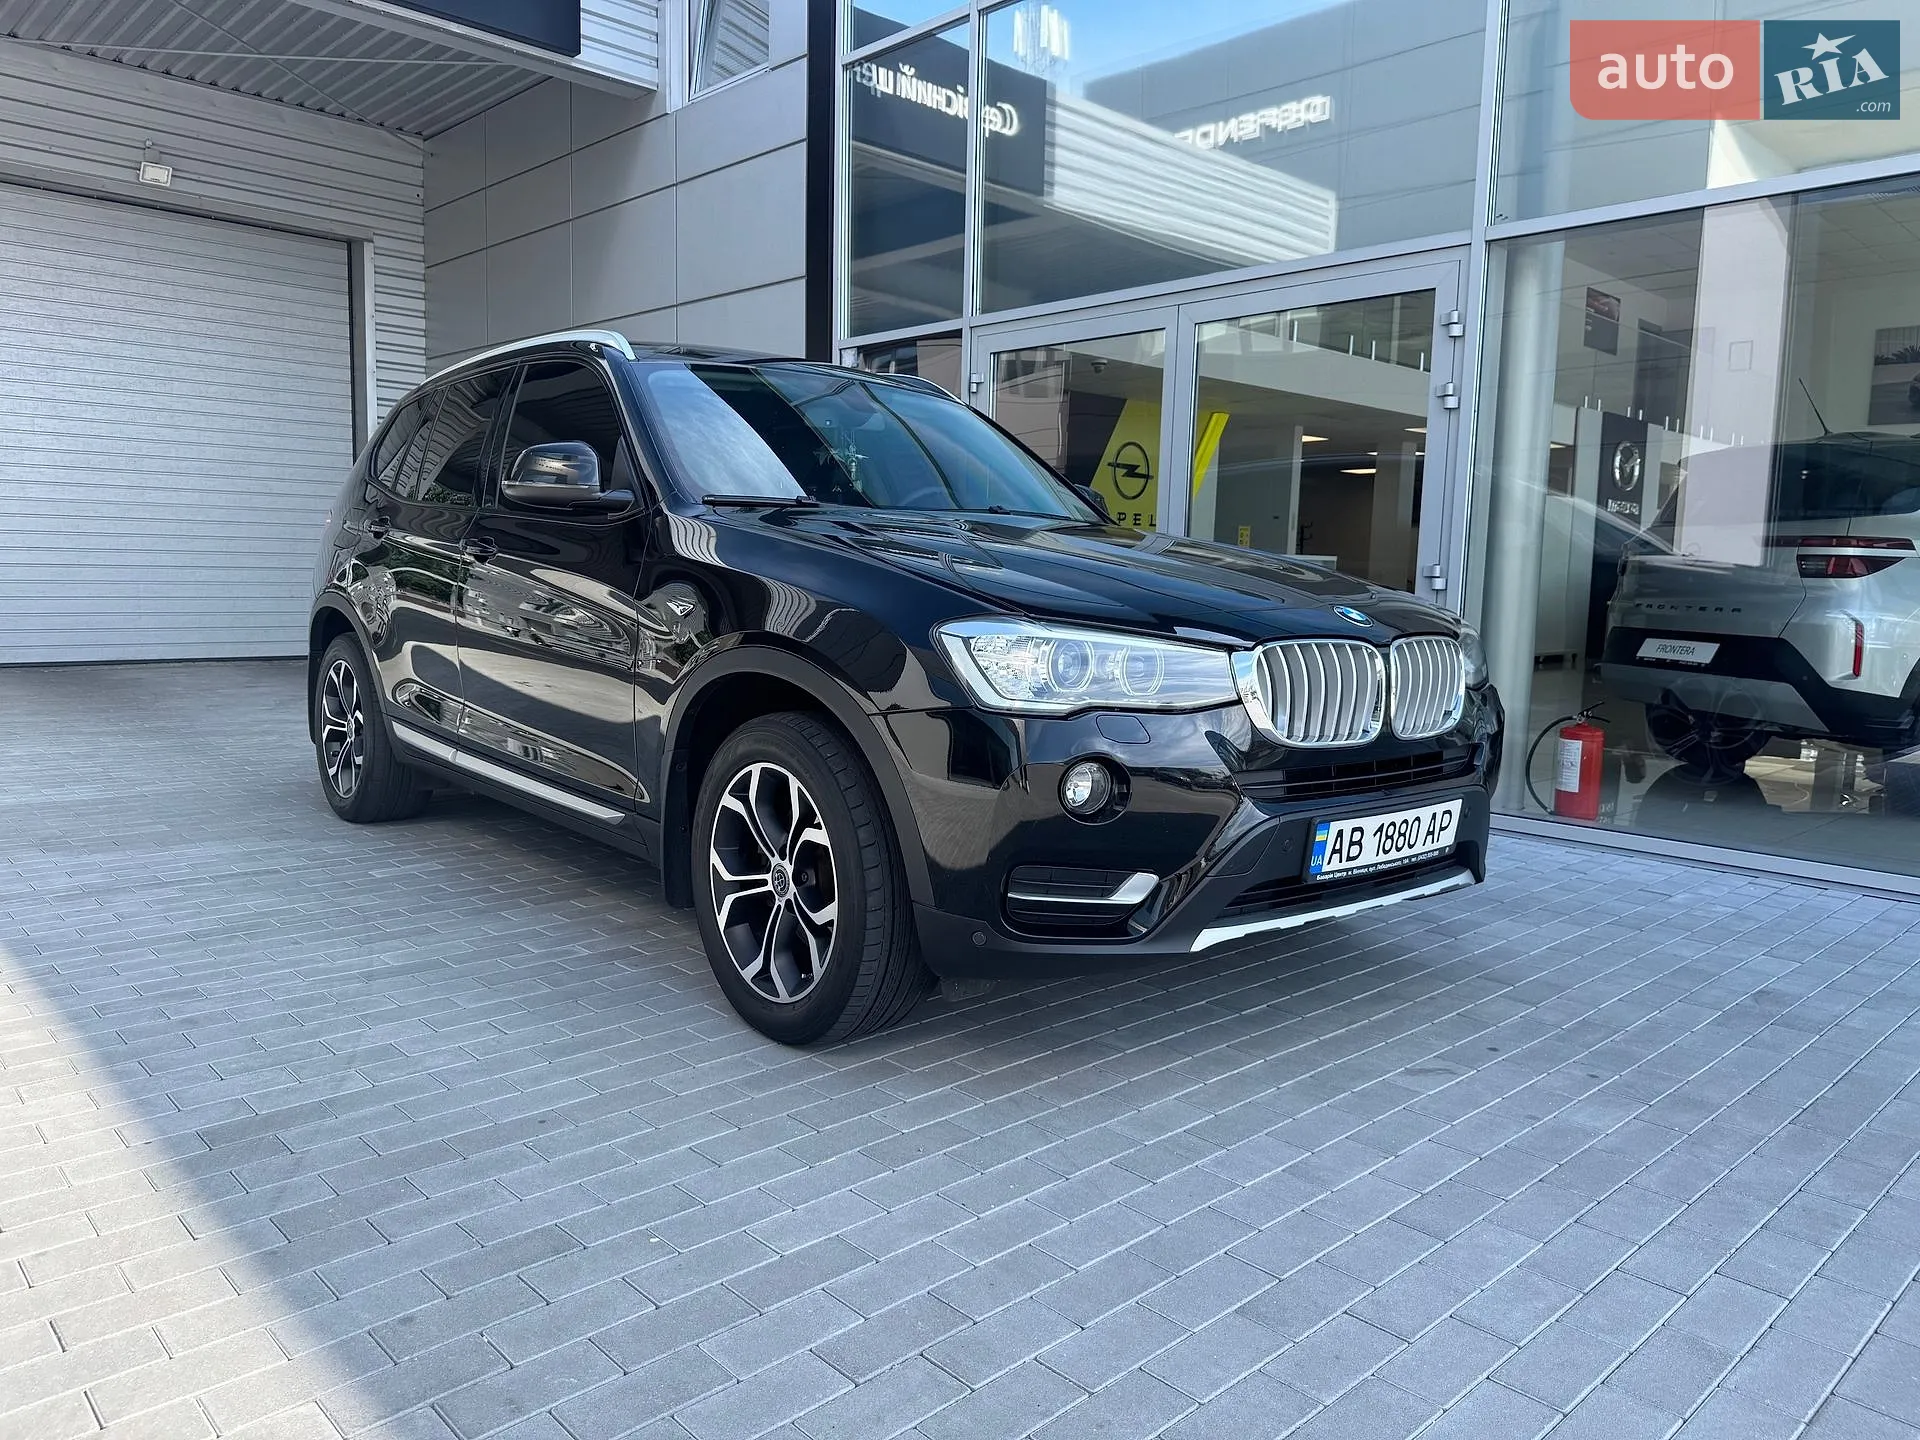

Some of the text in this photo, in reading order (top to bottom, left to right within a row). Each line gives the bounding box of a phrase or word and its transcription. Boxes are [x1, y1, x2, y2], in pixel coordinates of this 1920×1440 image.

[1117, 512, 1156, 526] PEL
[1656, 643, 1696, 656] FRONTERA
[1327, 826, 1365, 866] AB
[1373, 816, 1421, 857] 1880
[1422, 809, 1453, 847] AP
[1311, 855, 1322, 866] UA
